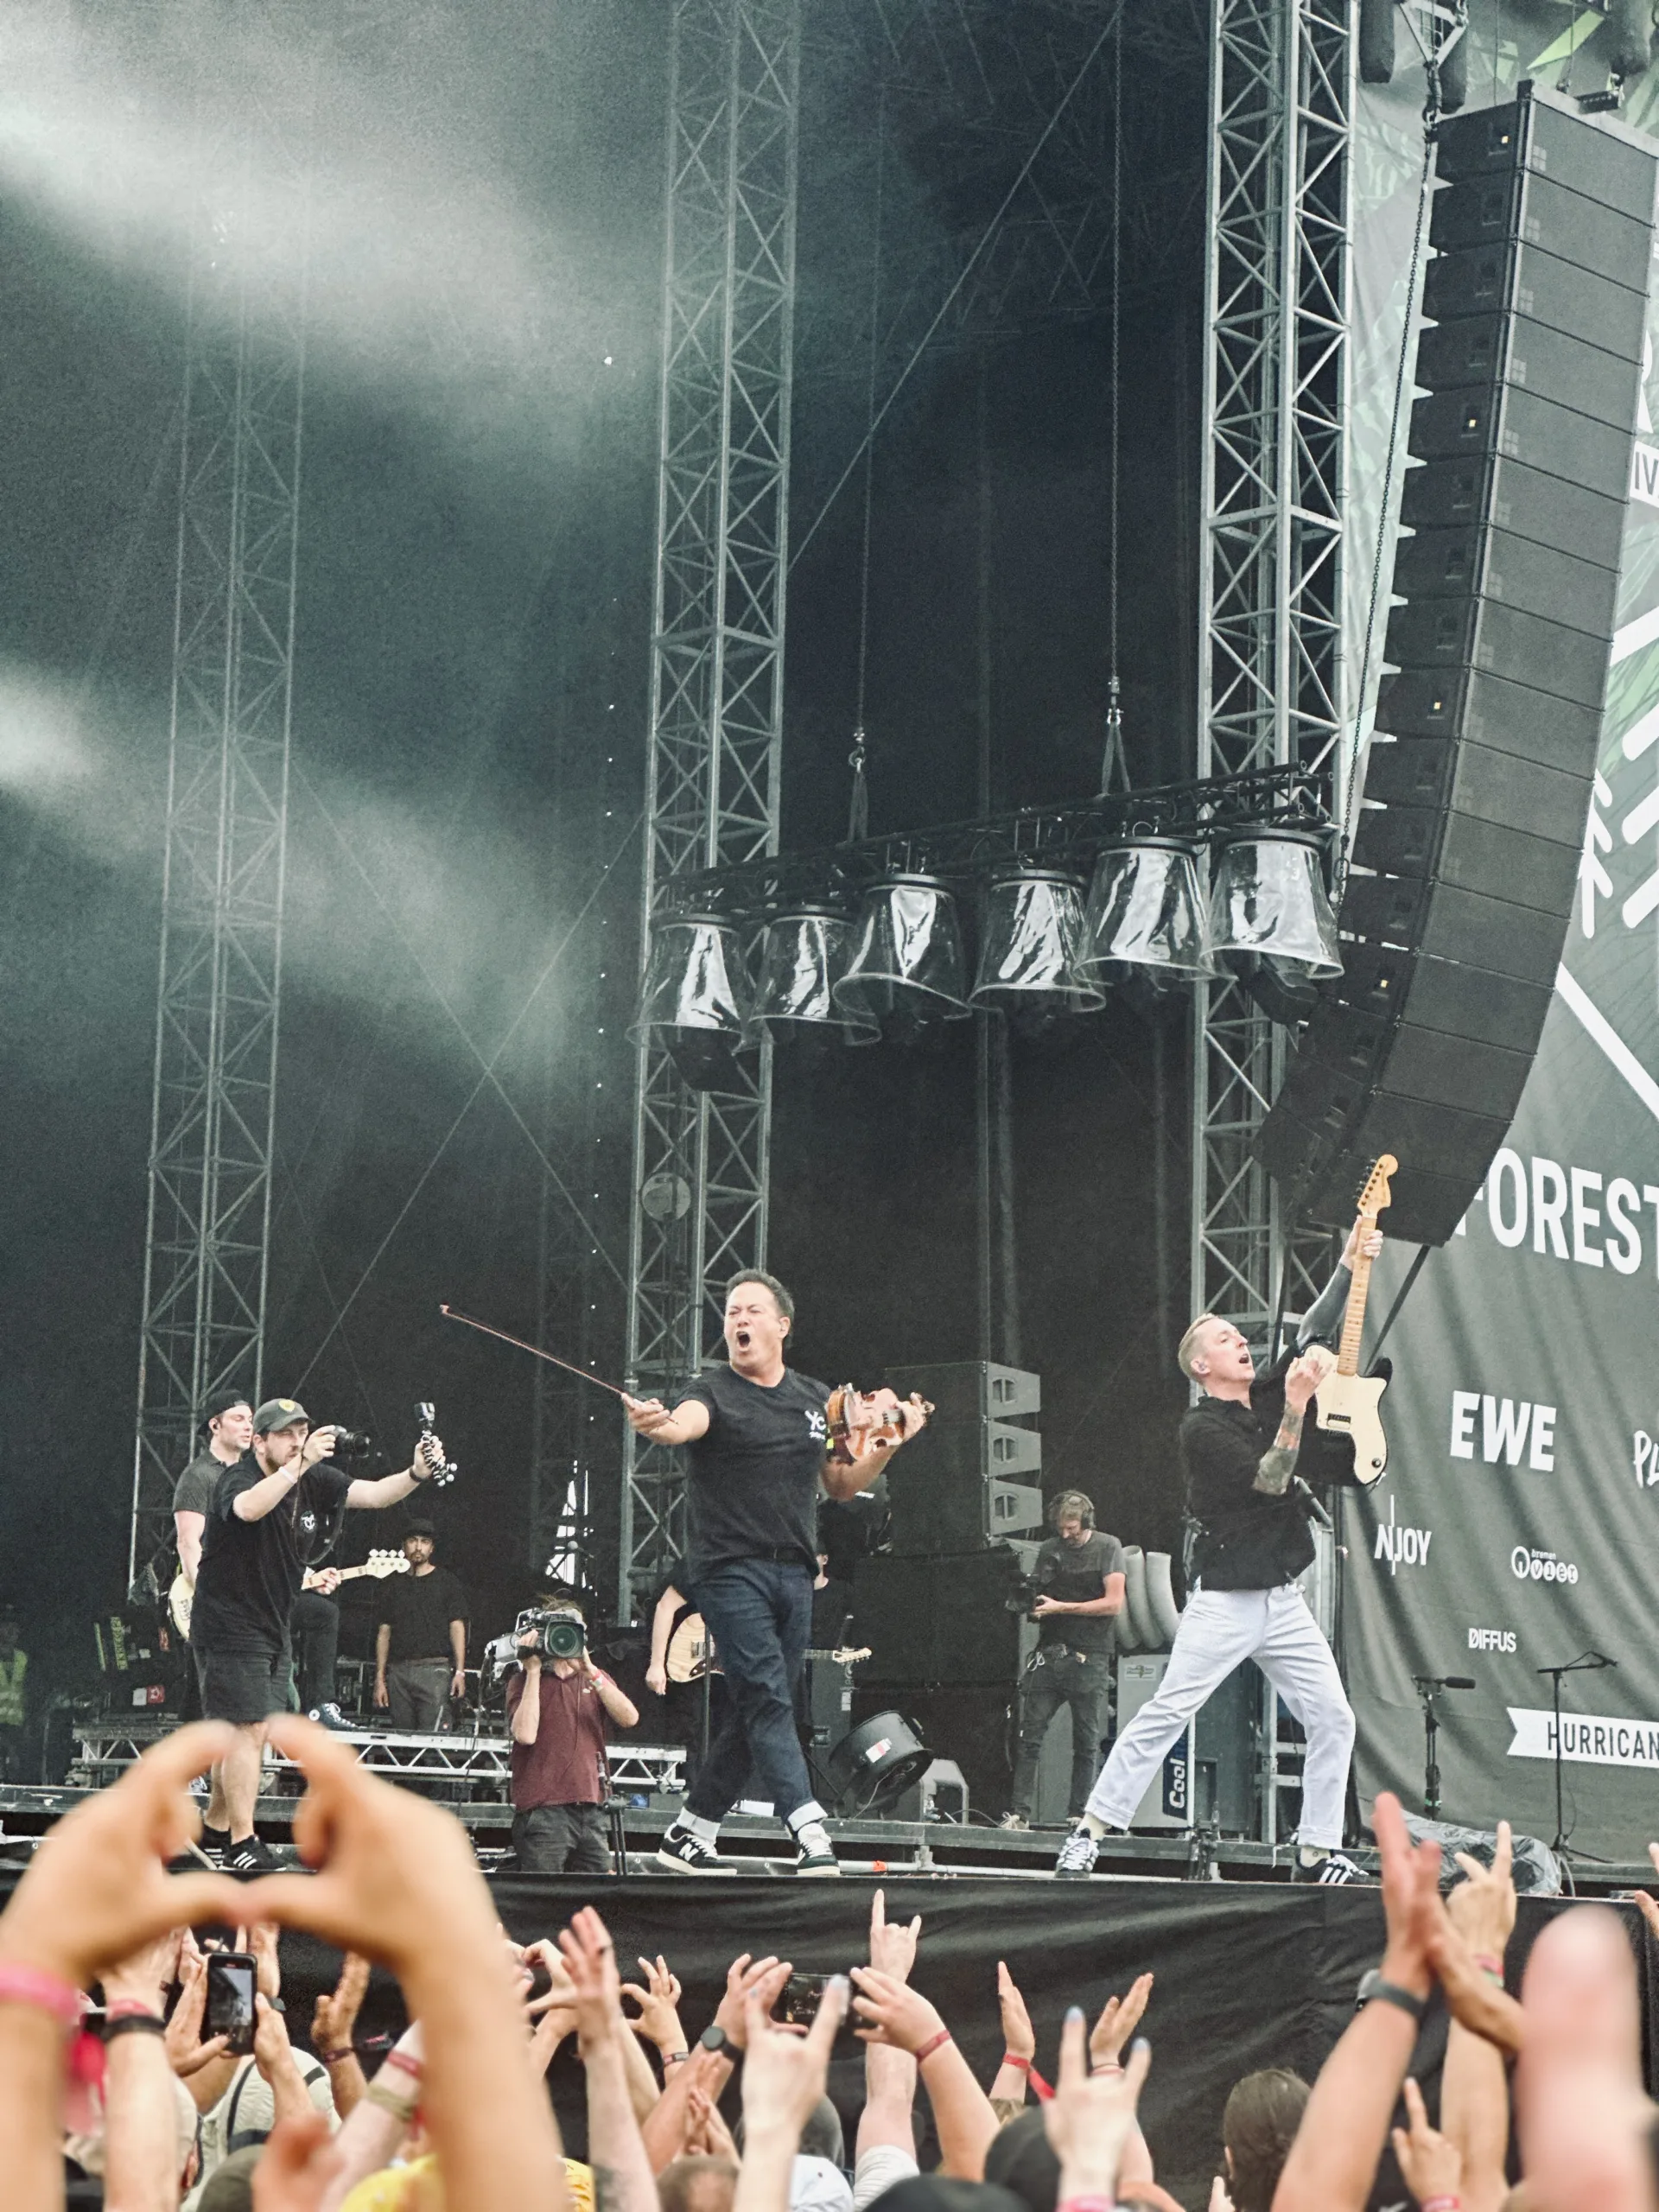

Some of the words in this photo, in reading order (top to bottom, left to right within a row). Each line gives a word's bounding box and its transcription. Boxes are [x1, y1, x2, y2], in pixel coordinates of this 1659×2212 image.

[1455, 1147, 1659, 1283] ORES
[1450, 1389, 1556, 1472] EWE
[1531, 1548, 1556, 1560] bremen
[1548, 1720, 1659, 1761] HURRICAN
[1169, 1758, 1185, 1808] Cool
